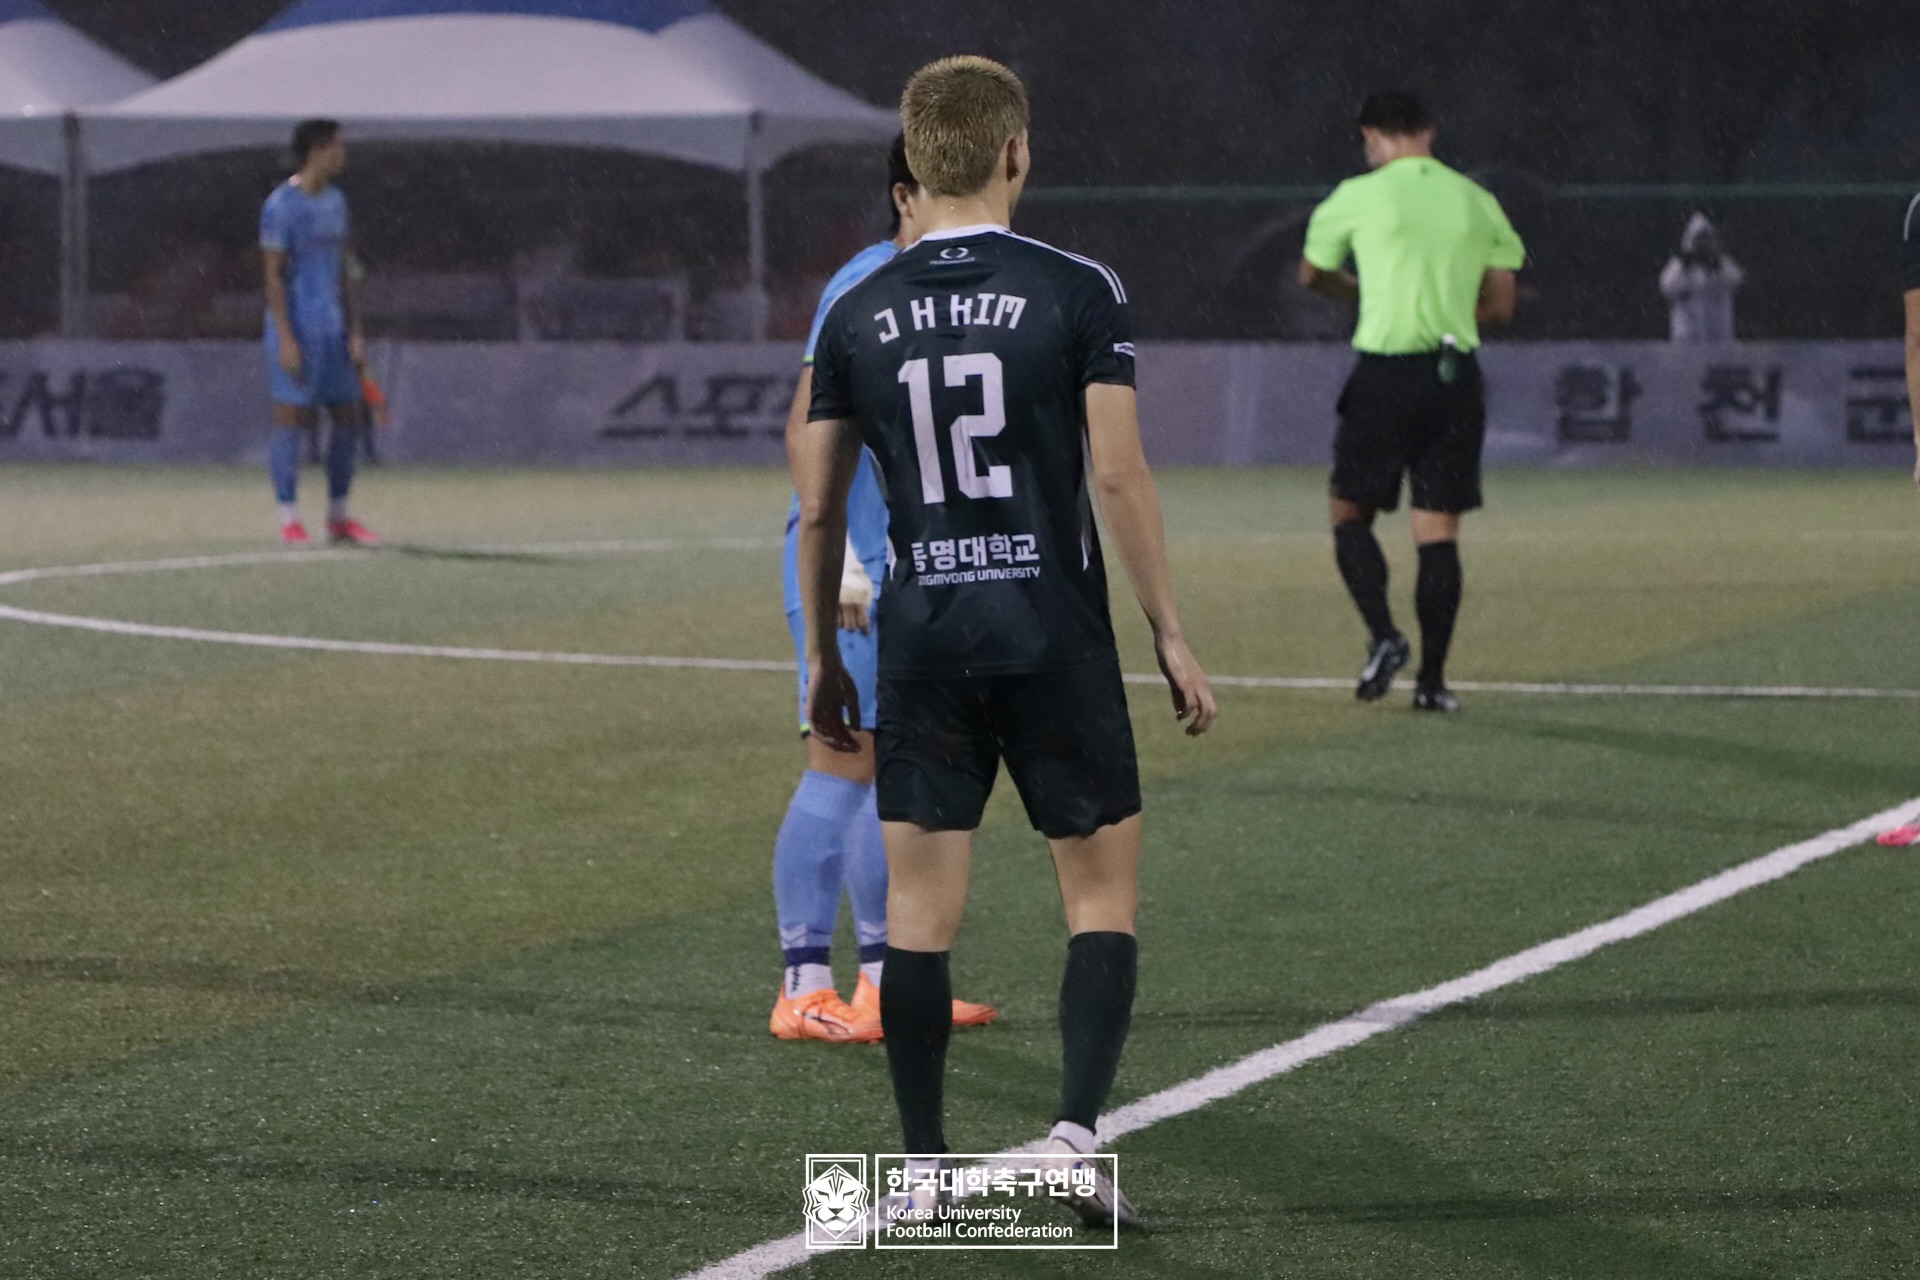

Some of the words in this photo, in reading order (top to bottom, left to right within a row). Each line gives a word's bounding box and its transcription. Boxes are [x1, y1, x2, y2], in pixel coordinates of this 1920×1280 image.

[874, 307, 900, 344] J
[910, 296, 936, 331] H
[950, 293, 1027, 330] KIM
[898, 352, 1013, 505] 12
[977, 565, 1041, 581] UNIVERSITY
